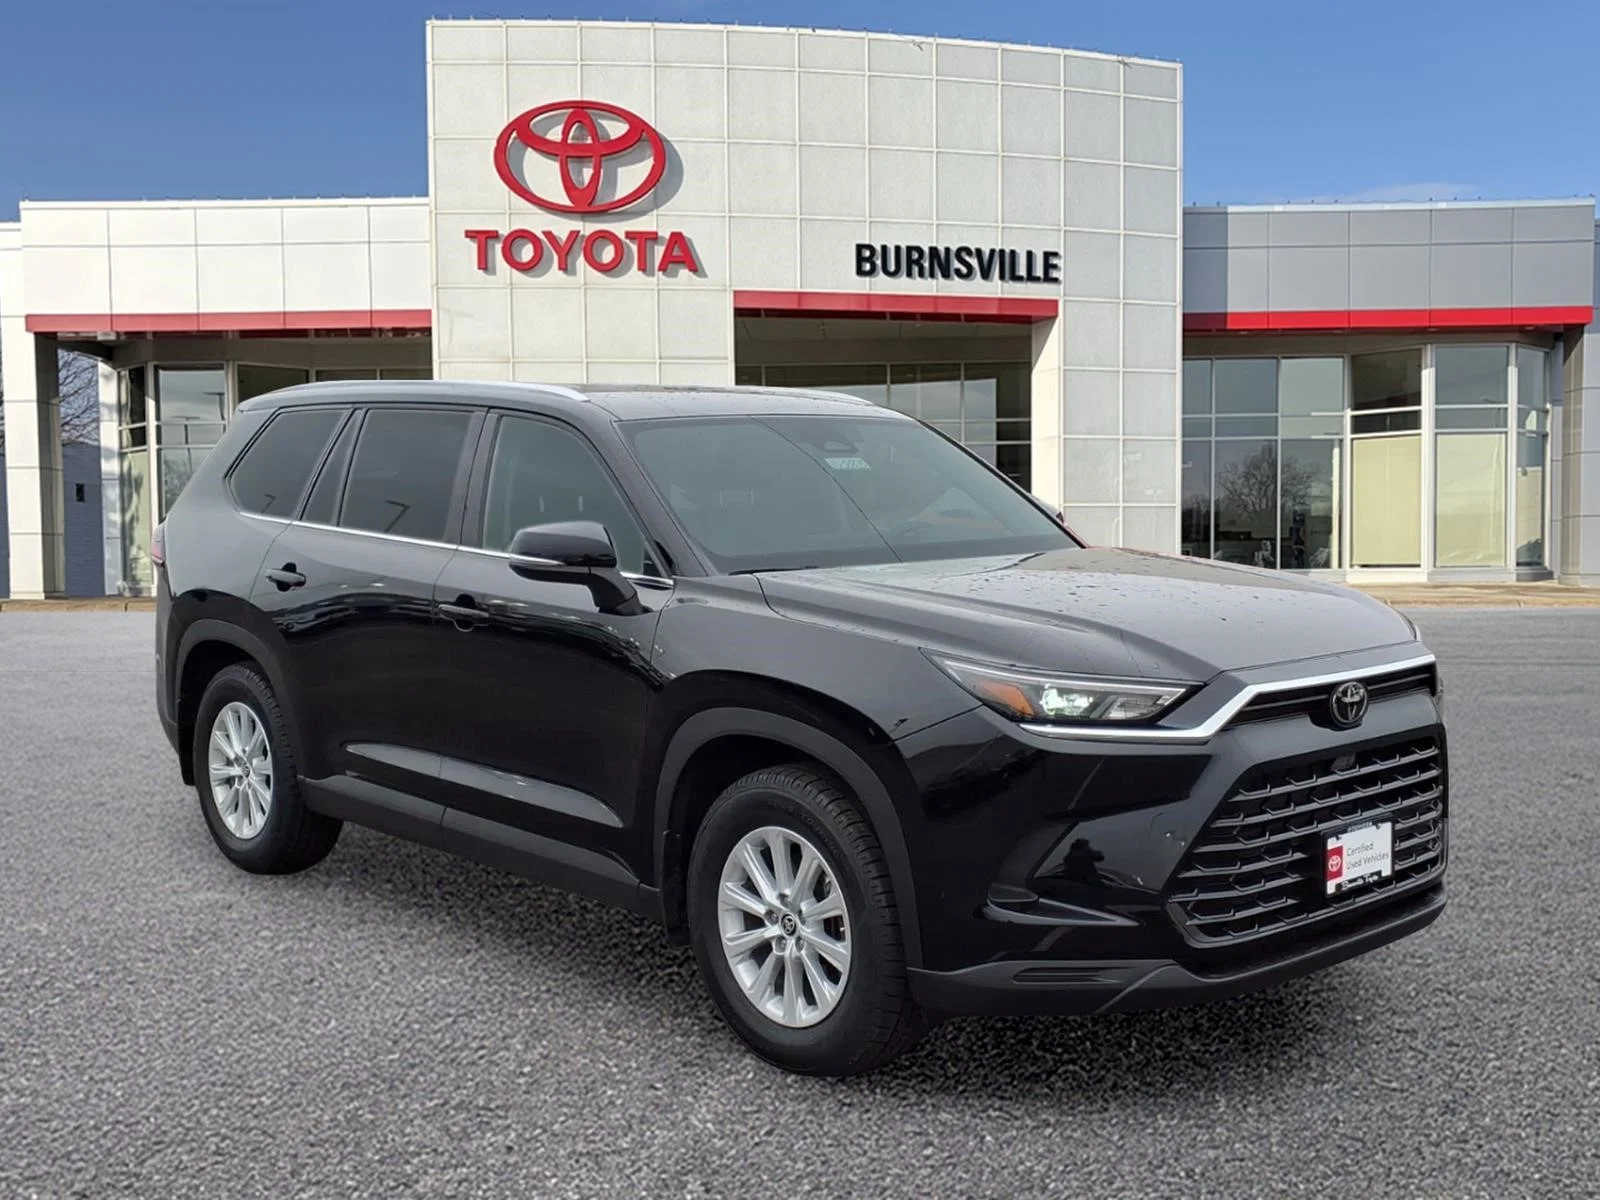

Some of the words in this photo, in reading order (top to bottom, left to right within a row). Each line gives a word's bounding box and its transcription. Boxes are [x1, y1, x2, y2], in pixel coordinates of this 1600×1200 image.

[465, 228, 699, 273] TOYOTA
[855, 243, 1061, 283] BURNSVILLE
[1347, 841, 1374, 857] Certified
[1347, 857, 1362, 870] Used
[1363, 850, 1390, 865] Vehicles
